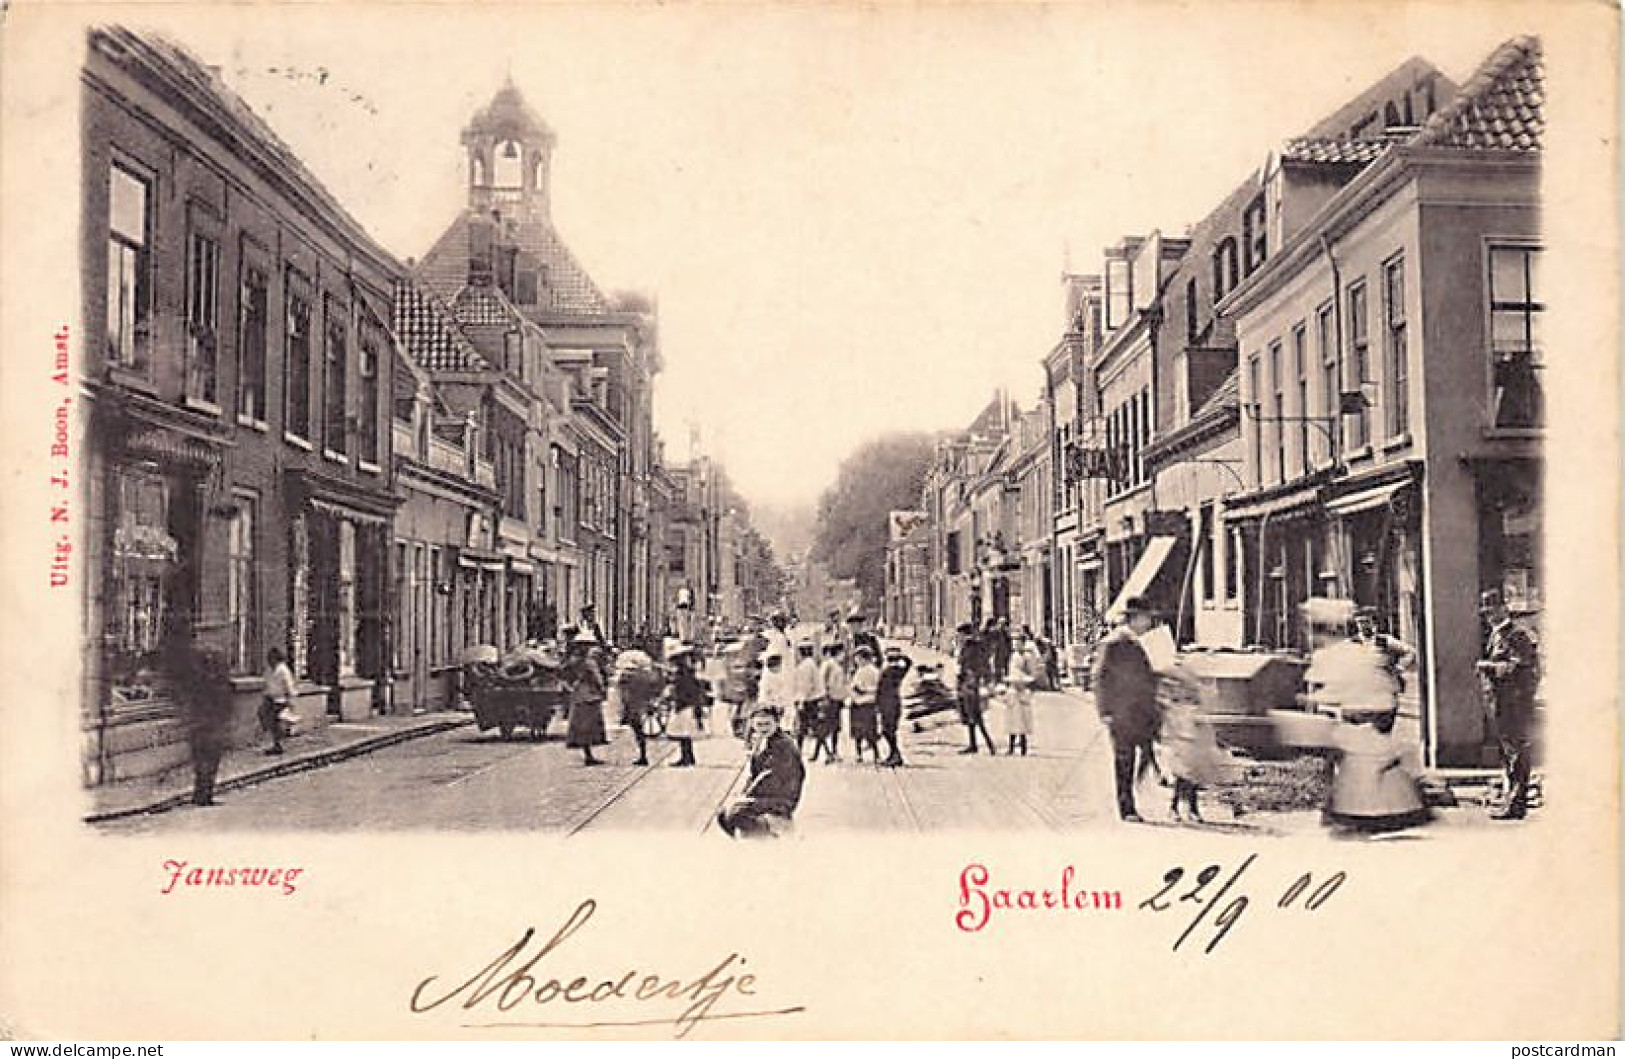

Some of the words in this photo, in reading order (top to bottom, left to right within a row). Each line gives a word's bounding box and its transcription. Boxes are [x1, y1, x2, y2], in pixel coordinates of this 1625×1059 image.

[51, 325, 70, 384] Amst.
[51, 398, 72, 459] Boon,
[50, 469, 70, 489] J.
[50, 501, 69, 523] N.
[50, 537, 72, 587] Uitg.
[162, 860, 305, 895] Jansweg
[954, 862, 1123, 933] Haarlem
[1138, 853, 1257, 955] 22/9
[411, 898, 758, 1037] Moedertje
